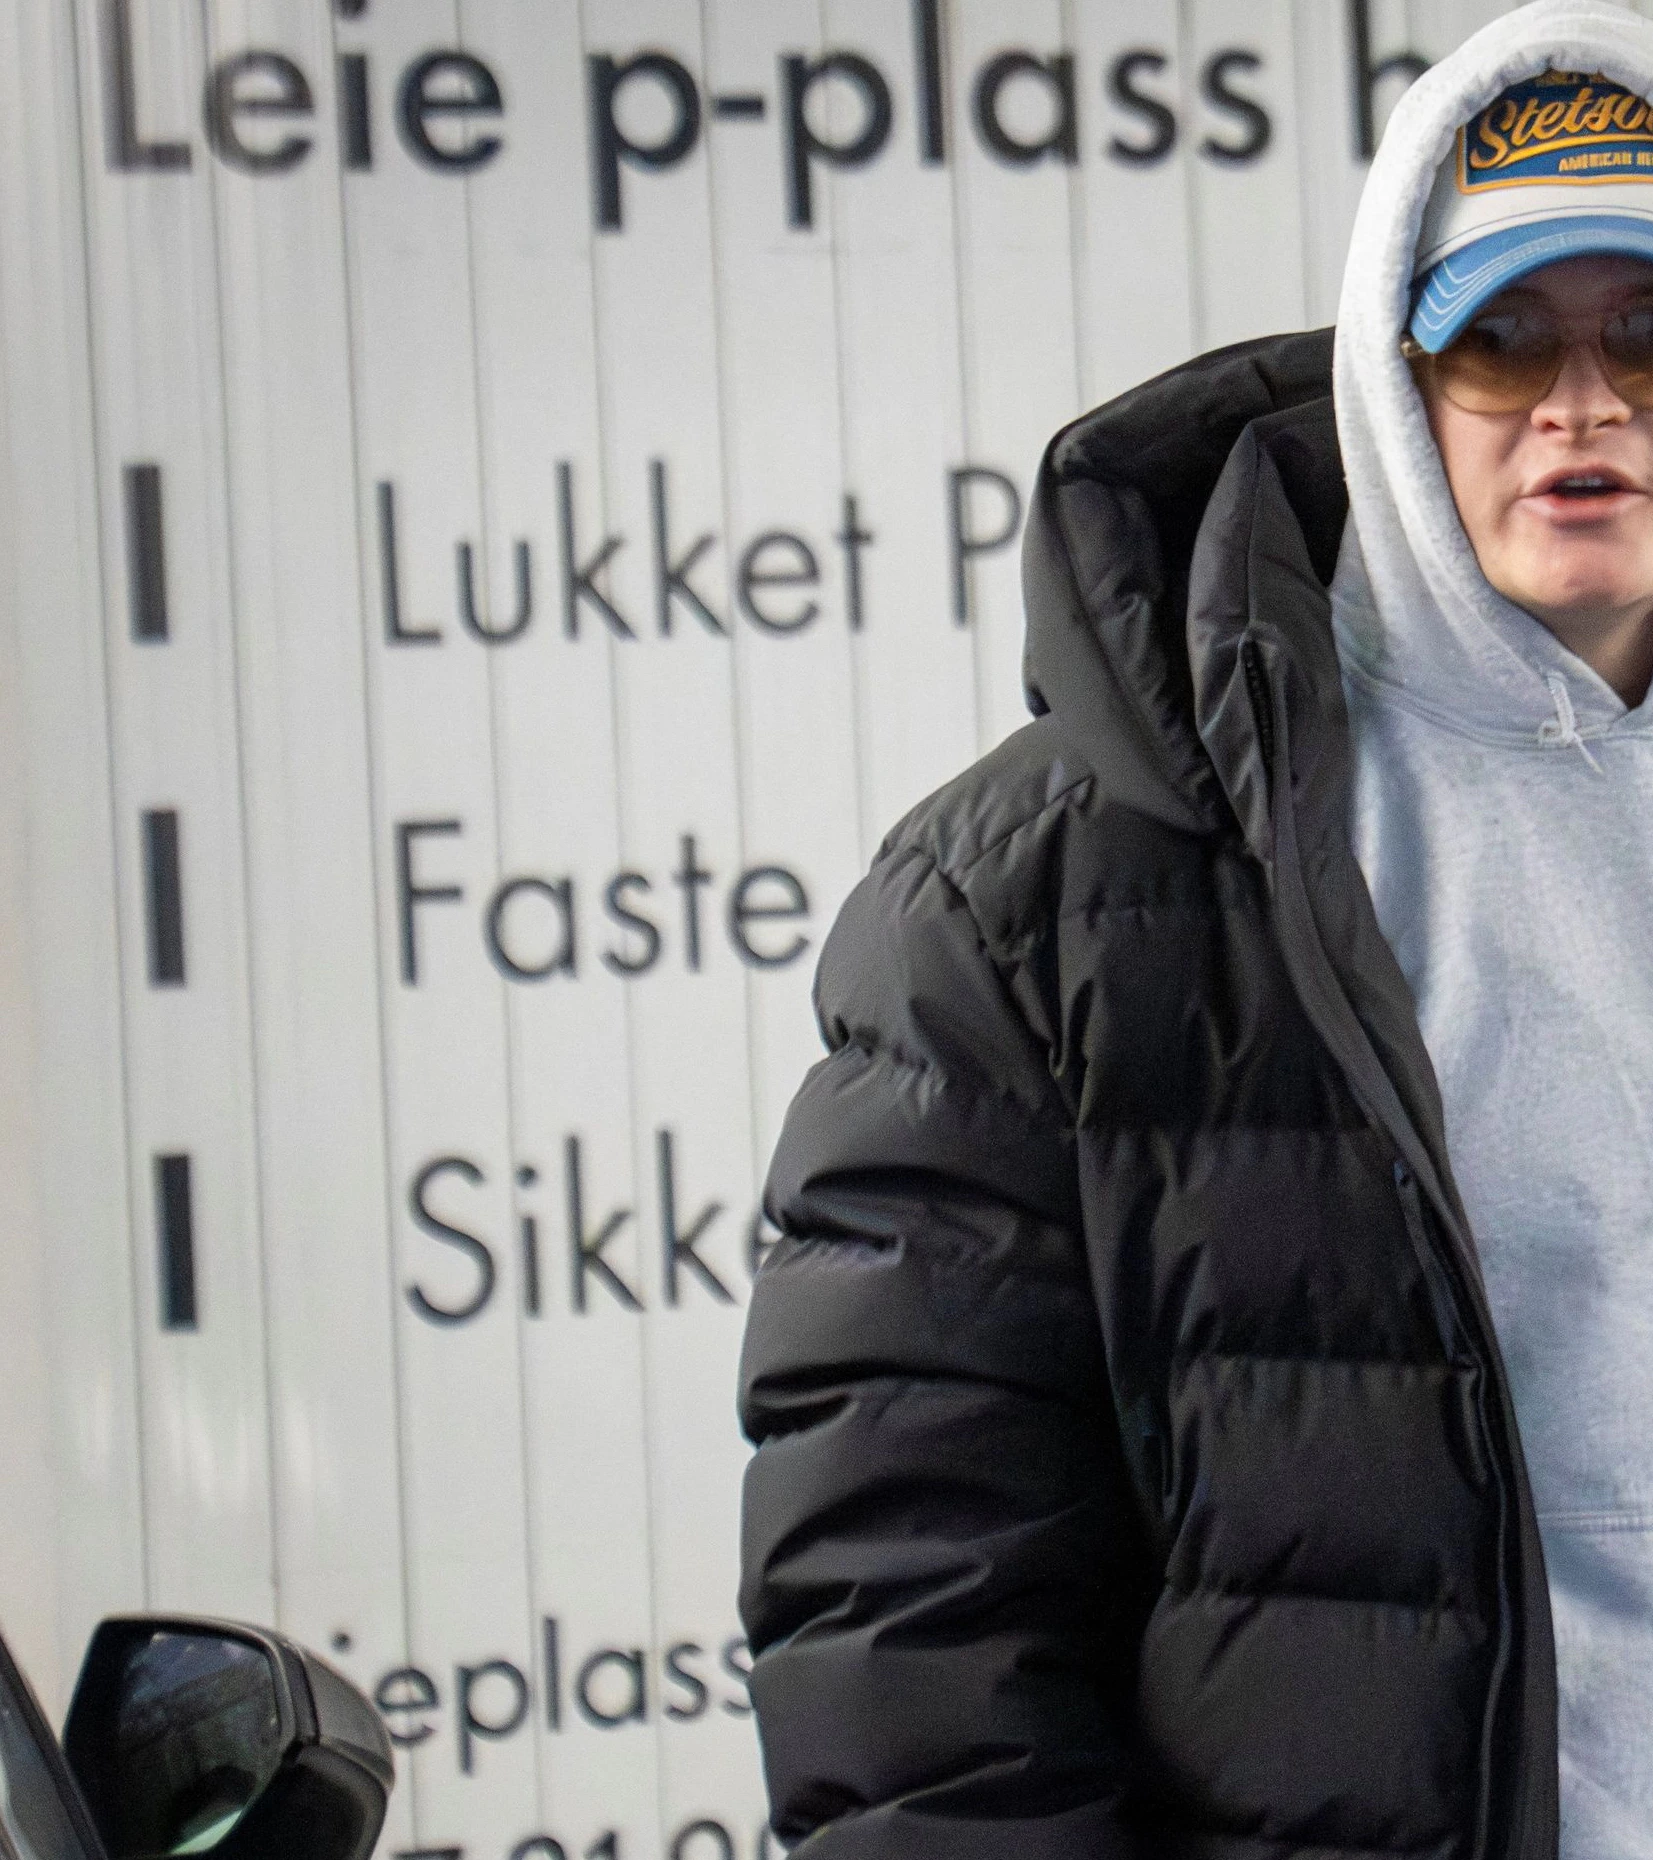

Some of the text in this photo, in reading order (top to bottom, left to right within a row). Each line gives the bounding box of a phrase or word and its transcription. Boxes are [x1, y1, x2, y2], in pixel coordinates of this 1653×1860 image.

[97, 0, 505, 174] Leie
[584, 0, 1274, 232] p-plass
[375, 457, 874, 649] Lukket
[393, 819, 812, 987] Faste
[329, 1616, 752, 1776] eplass
